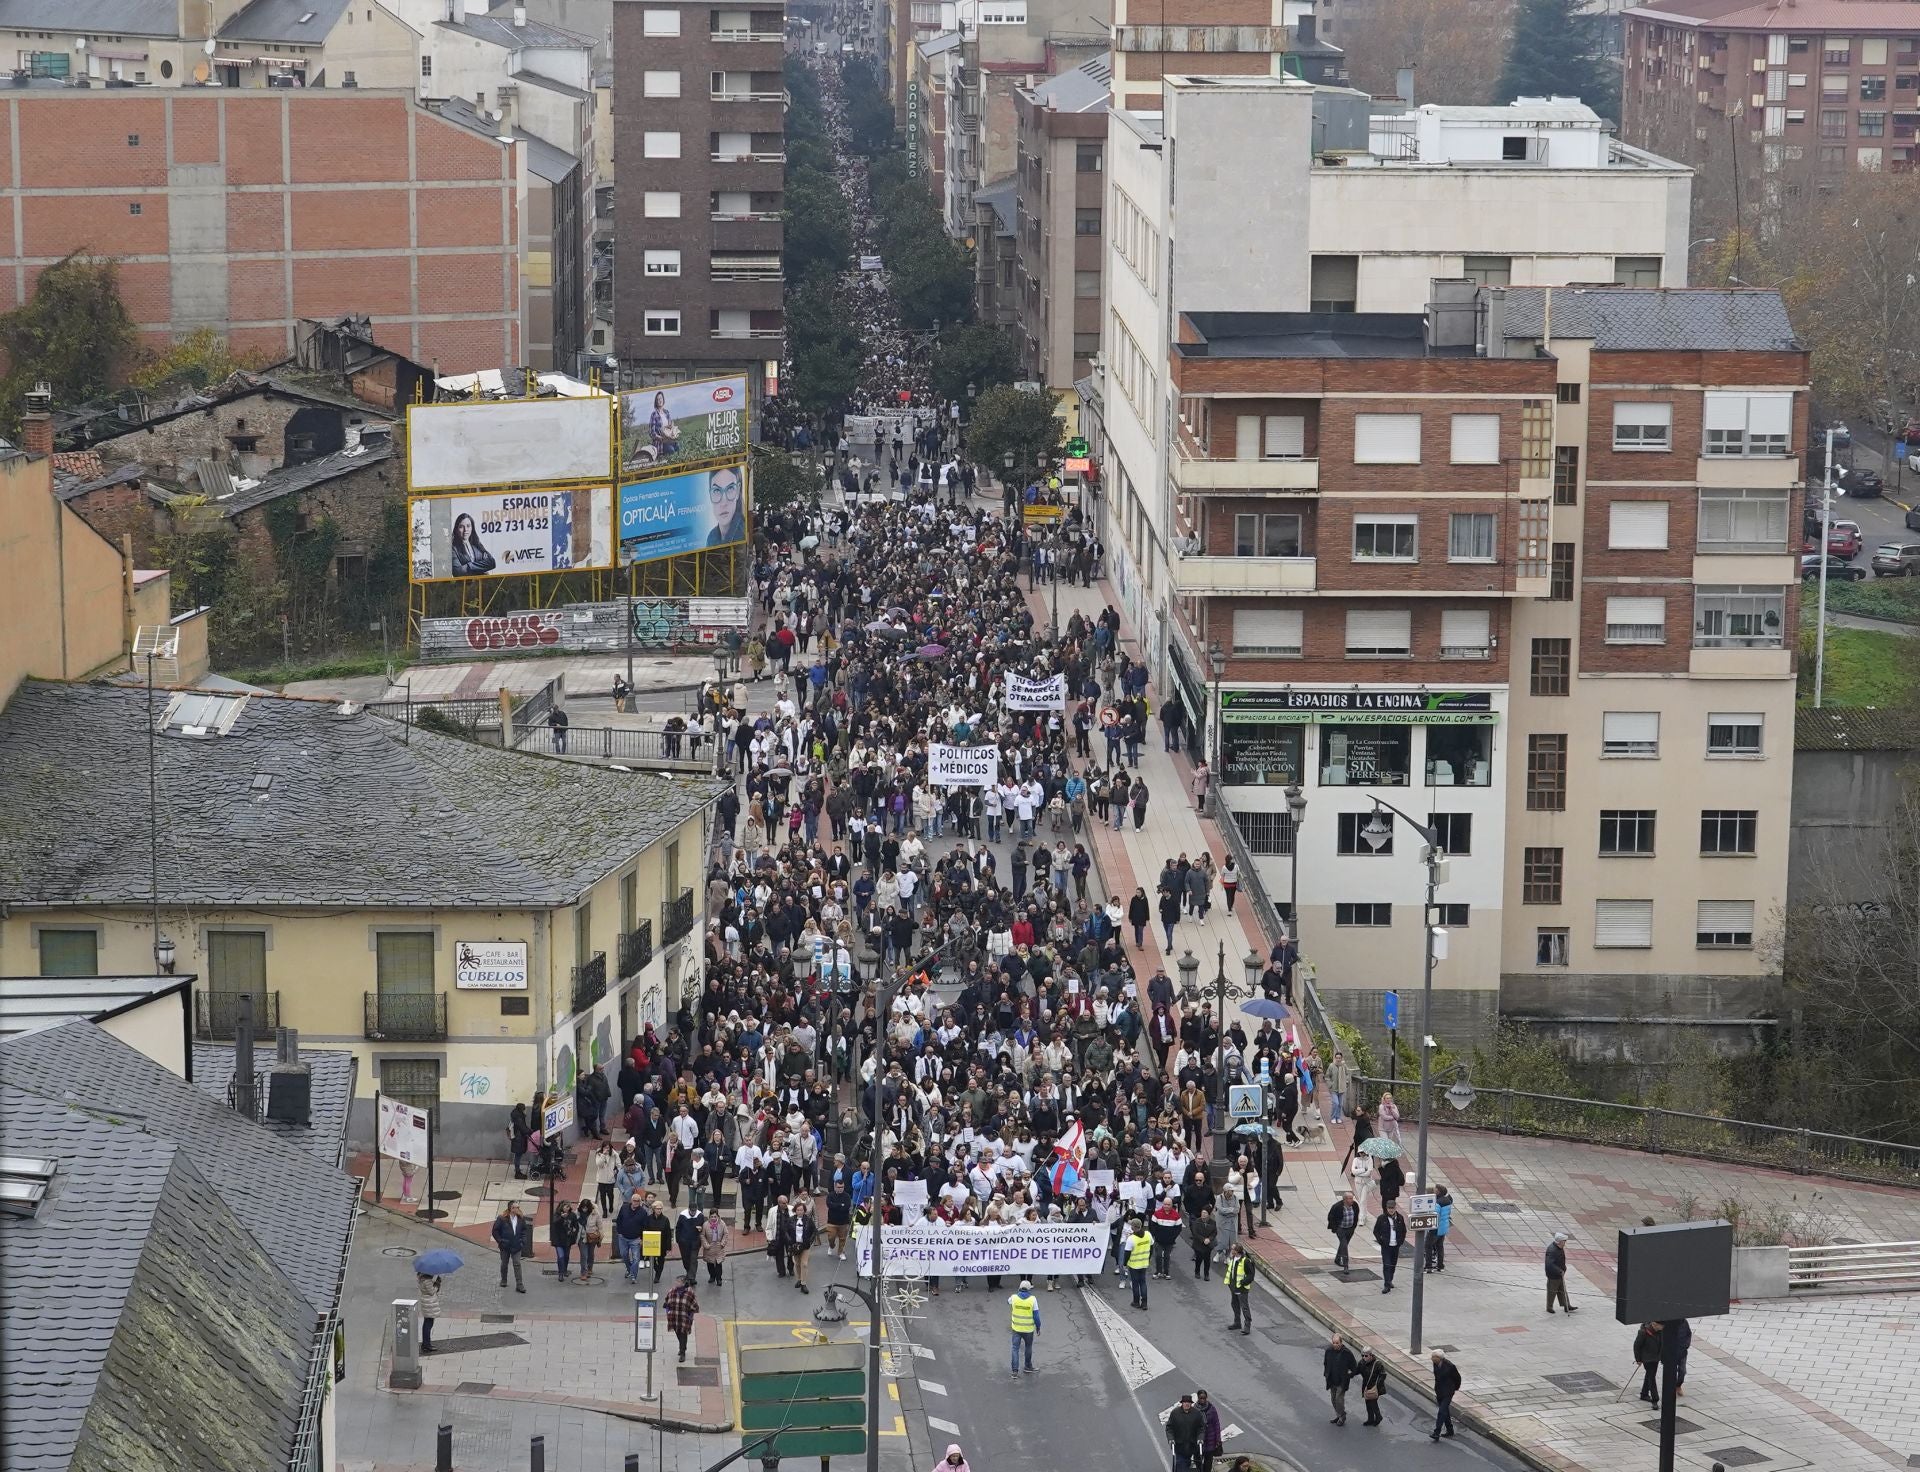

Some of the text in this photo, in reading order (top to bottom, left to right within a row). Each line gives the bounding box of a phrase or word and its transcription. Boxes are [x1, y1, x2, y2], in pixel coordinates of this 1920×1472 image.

[908, 124, 916, 178] BIERZO
[708, 410, 737, 433] MEJOR
[706, 427, 739, 450] MEJORES
[503, 496, 548, 510] ESPACIO
[482, 508, 548, 522] DISPONIBLE
[678, 504, 705, 516] FERNANDO
[481, 518, 548, 533] 902 731 432
[1025, 685, 1060, 693] MERECE
[1289, 694, 1422, 707] ESPACIOS LA ENCINA
[940, 748, 994, 759] POLÍTICOS
[940, 761, 988, 774] MÉDICOS
[1228, 762, 1295, 771] FINANCIACIÓN
[1351, 761, 1376, 771] SIN
[458, 971, 524, 981] CUBELOS
[1427, 1218, 1436, 1226] Sil
[975, 1236, 1024, 1245] SANIDAD
[883, 1248, 935, 1260] CÁNCER
[941, 1250, 959, 1260] NO
[962, 1249, 1027, 1260] ENTIENDE
[1031, 1249, 1048, 1259] DE
[1052, 1248, 1101, 1259] TIEMPO
[953, 1265, 1010, 1273] #ONCOBIERZO
